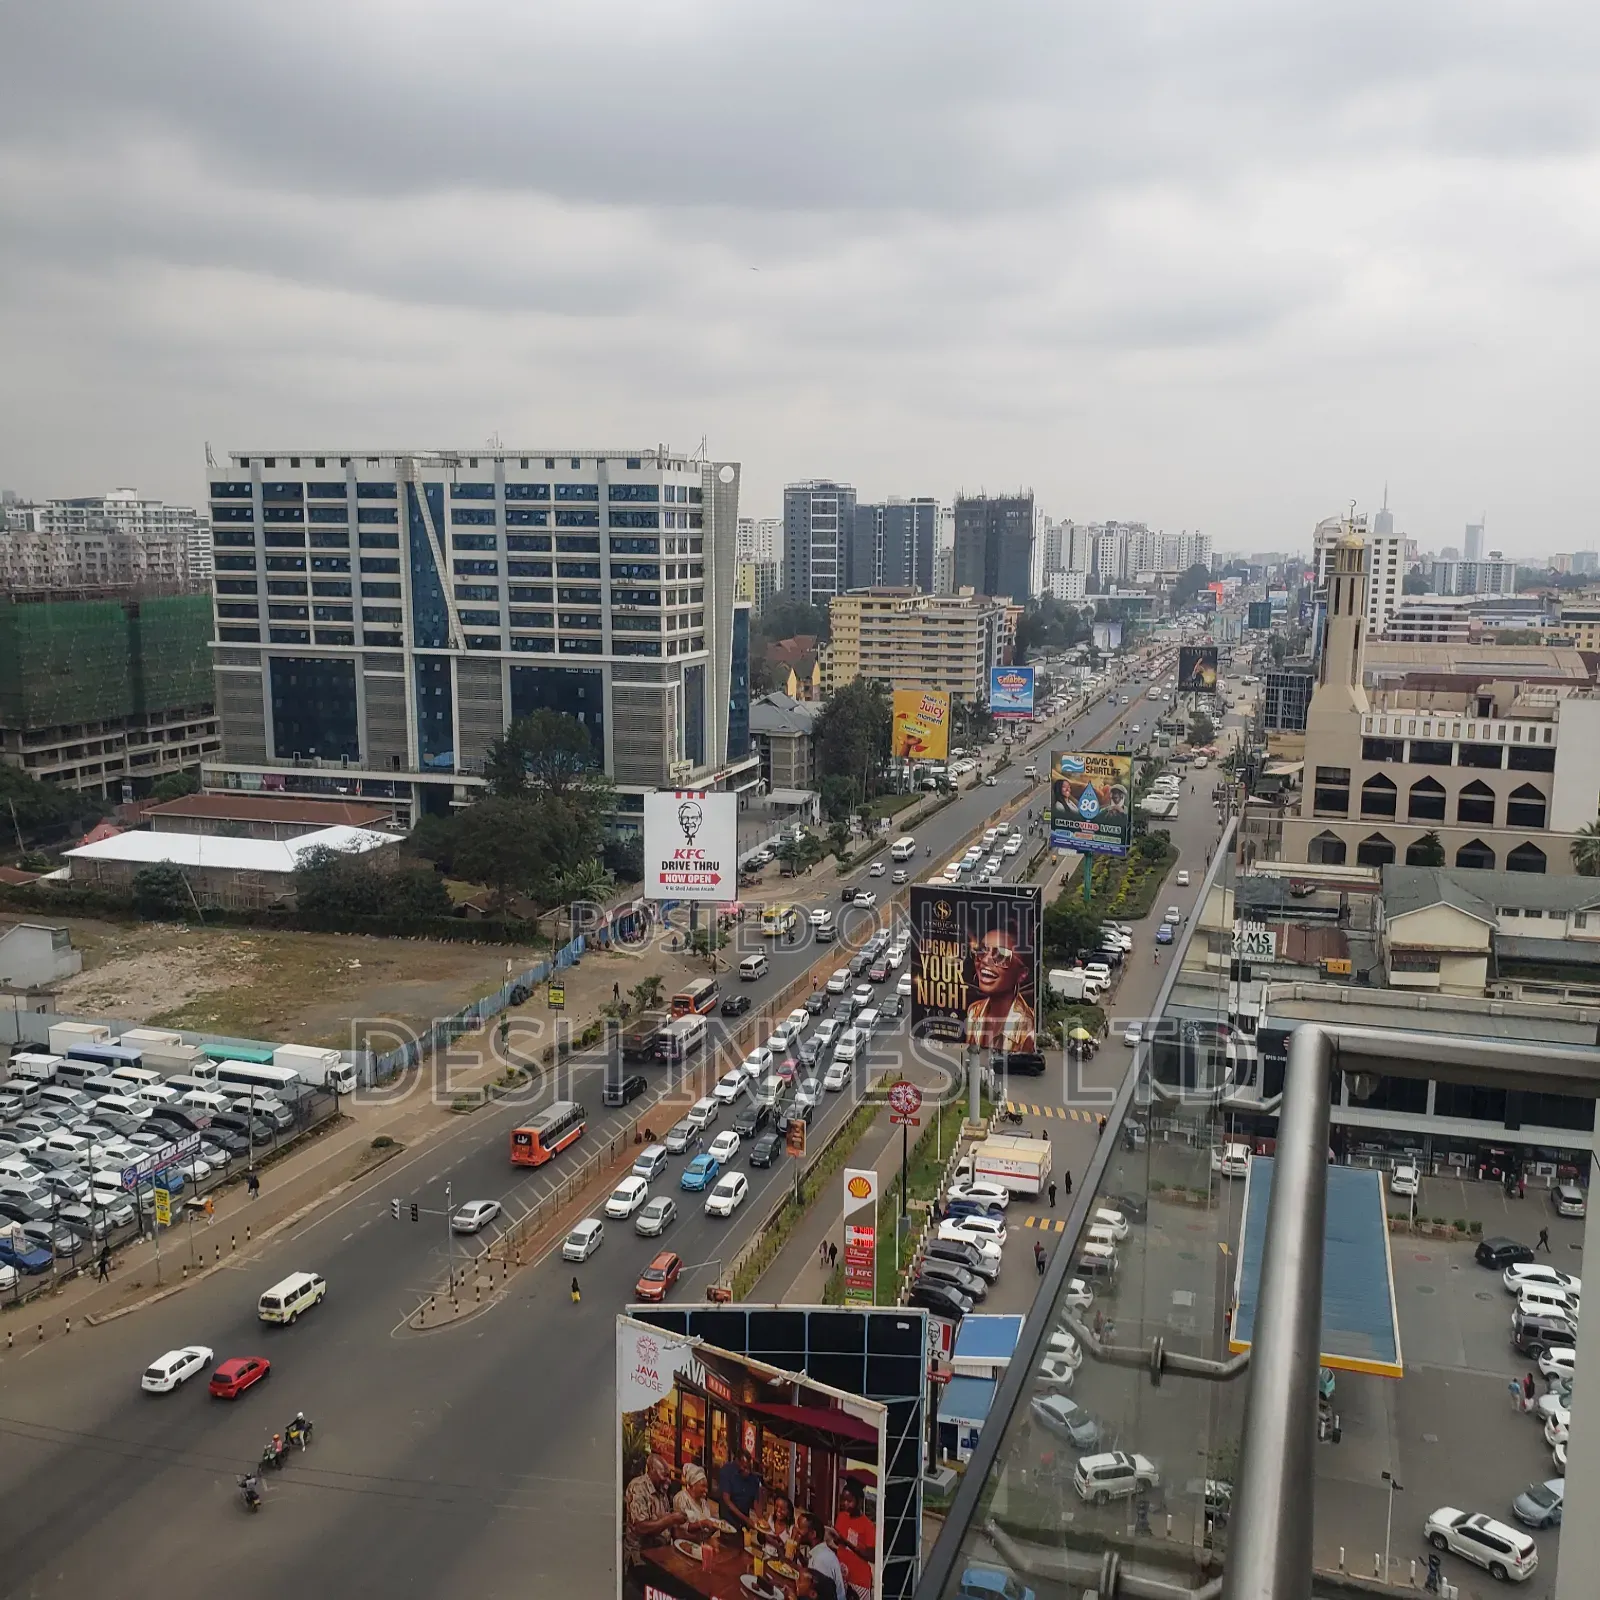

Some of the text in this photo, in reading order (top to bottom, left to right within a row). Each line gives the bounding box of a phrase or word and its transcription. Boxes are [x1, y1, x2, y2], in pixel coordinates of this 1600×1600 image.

[919, 700, 945, 719] Juicy
[917, 712, 943, 726] moment
[1085, 756, 1114, 768] DAVIS &
[1085, 765, 1122, 777] SHIRTLIFF
[1080, 798, 1098, 813] 80
[1055, 819, 1099, 831] IMPROVING
[1100, 824, 1121, 835] LIVES
[673, 848, 706, 860] KFC
[661, 860, 720, 872] DRIVE THRU
[665, 873, 712, 884] NOW OPEN
[924, 919, 961, 931] SYNDICATE
[919, 938, 967, 959] UPGRADE
[920, 955, 965, 985] YOUR
[916, 976, 969, 1011] NIGHT
[896, 1116, 913, 1126] JAVA
[160, 1143, 177, 1161] CAR
[177, 1130, 201, 1153] SALES
[856, 1269, 872, 1278] KFC
[635, 1364, 659, 1381] JAVA
[630, 1372, 664, 1393] HOUSE
